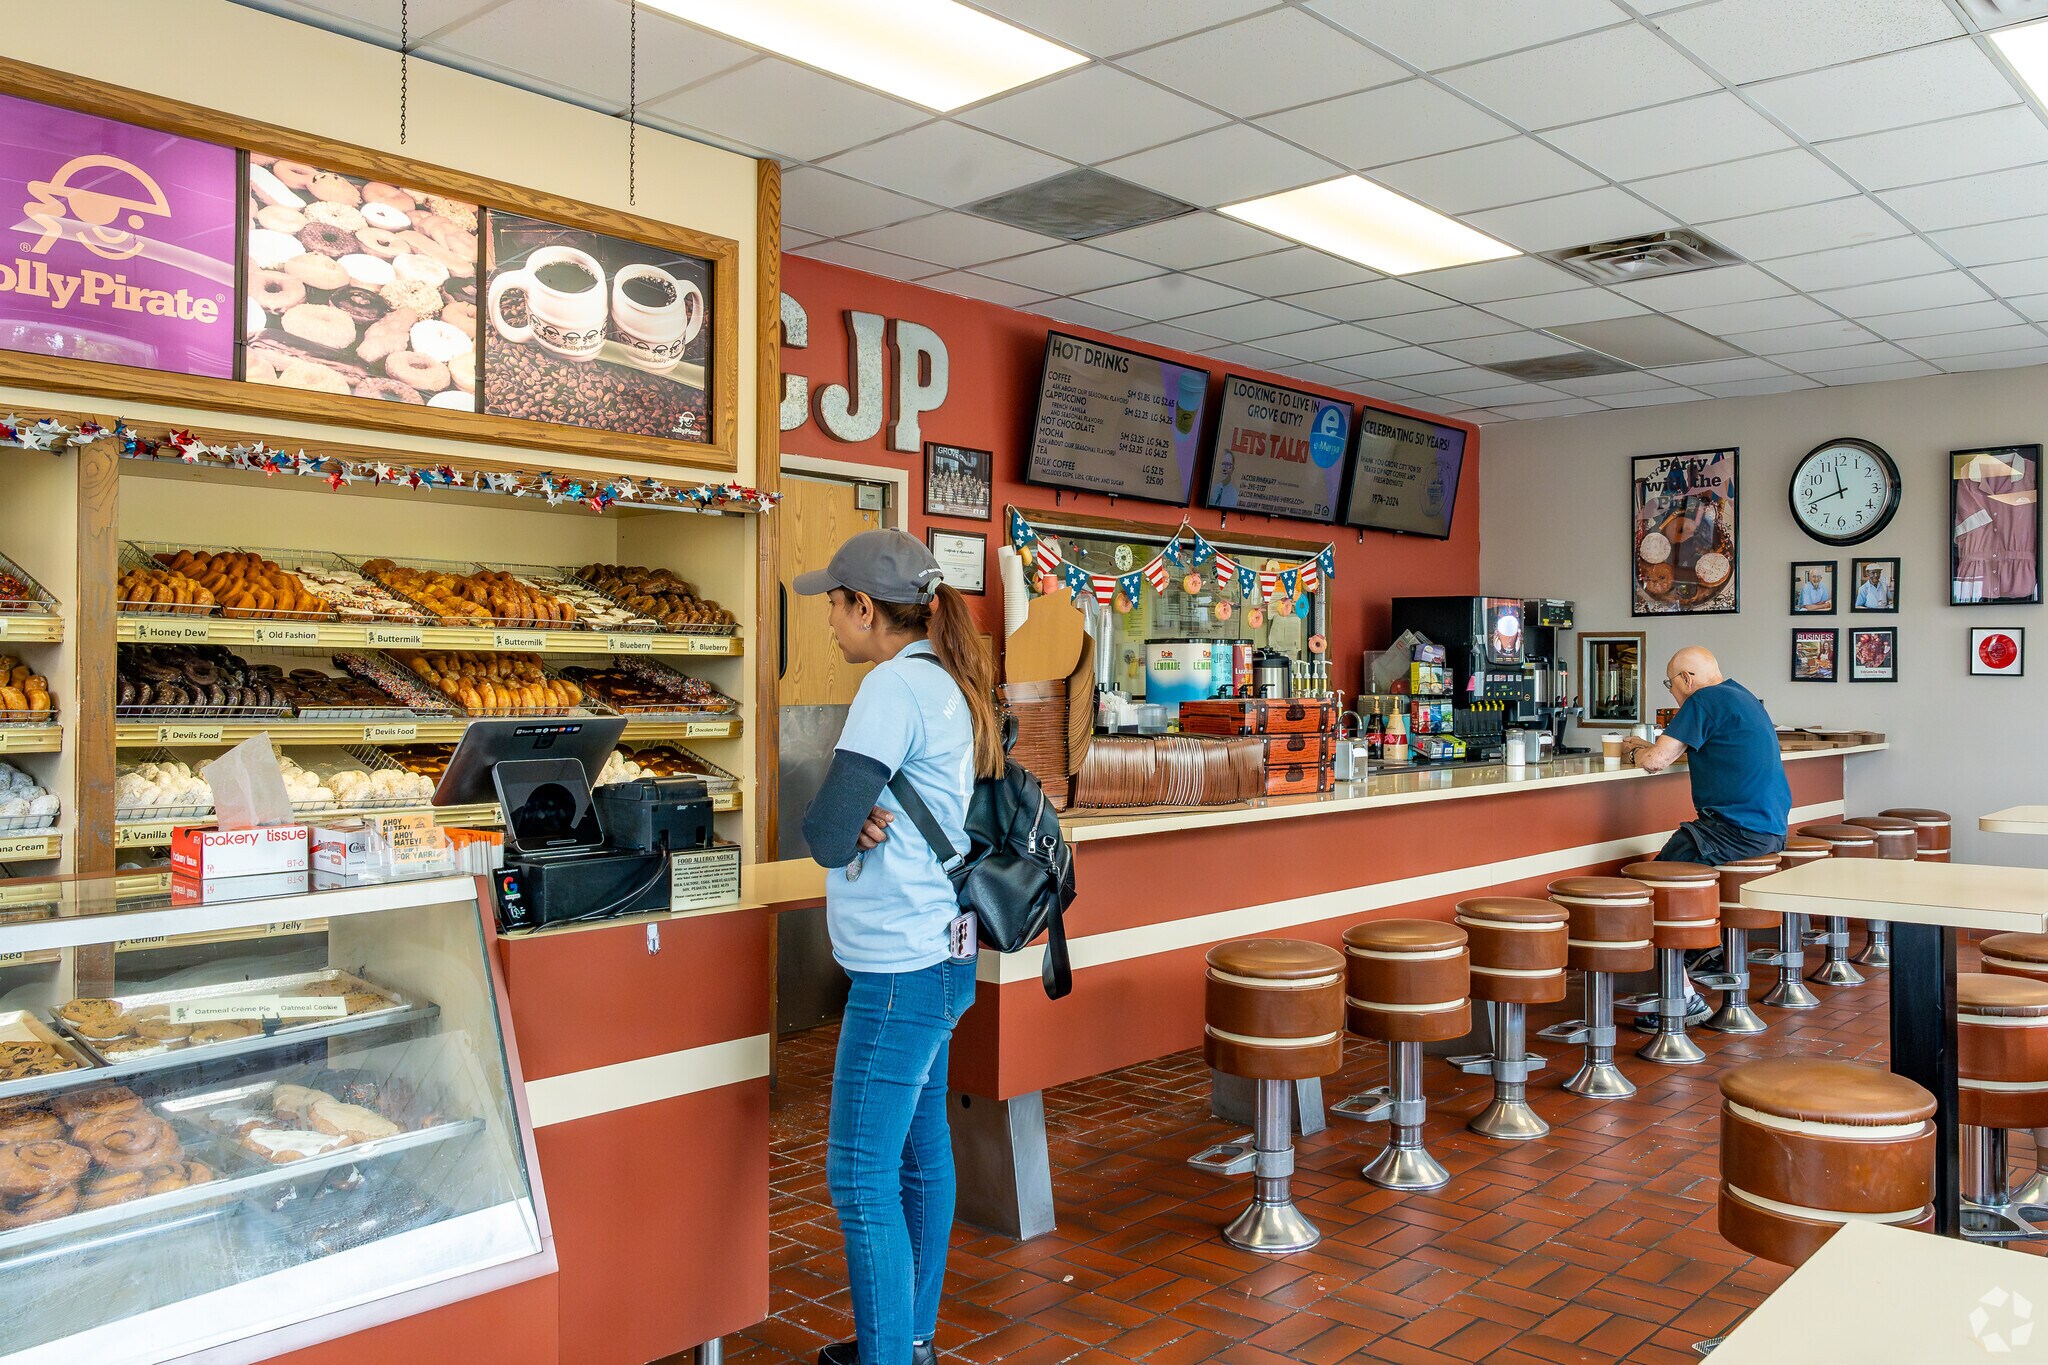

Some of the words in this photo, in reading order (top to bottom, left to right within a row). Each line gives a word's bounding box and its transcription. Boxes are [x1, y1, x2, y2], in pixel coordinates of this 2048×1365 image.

[1052, 340, 1082, 362] HOT
[1084, 347, 1129, 373] DRINKS
[1048, 371, 1071, 383] COFFEE
[1127, 390, 1136, 399] SM
[1152, 396, 1160, 404] LG
[1234, 382, 1276, 403] LOOKING
[1278, 392, 1290, 406] TO
[1292, 395, 1309, 412] LIVE
[1310, 400, 1320, 412] IN
[1045, 390, 1086, 406] CAPPUCCINO
[1124, 407, 1134, 417] SM
[1134, 409, 1149, 420] $3.25
[1151, 413, 1158, 422] LG
[1248, 404, 1278, 422] GROVE
[1280, 411, 1303, 427] CITY?
[1041, 415, 1056, 425] HOT
[1057, 419, 1095, 433] CHOCOLATE
[1120, 432, 1130, 441] SM
[1130, 433, 1145, 444] $3.25
[1147, 437, 1154, 446] LG
[1364, 420, 1414, 443] CELEBRATING
[1415, 432, 1424, 446] 50
[1426, 434, 1450, 451] YEARS!
[1039, 427, 1064, 438] MOCHA
[1119, 443, 1128, 452] SM
[1128, 445, 1143, 455] $3.25
[1145, 447, 1152, 456] LG
[1035, 456, 1051, 467] BULK
[1053, 459, 1076, 471] COFFEE
[1036, 445, 1047, 455] TEA
[1142, 465, 1150, 474] LG
[1659, 457, 1708, 472] Party
[1834, 456, 1847, 467] 12
[1854, 459, 1859, 469] 1
[1821, 462, 1831, 473] 11
[1864, 467, 1872, 478] 2
[1693, 474, 1721, 488] the
[1810, 474, 1823, 485] 10
[1804, 488, 1813, 499] 9
[1871, 483, 1879, 493] 3
[1809, 503, 1818, 514] 8
[1865, 498, 1873, 509] 4
[1823, 513, 1830, 524] 7
[1837, 515, 1846, 527] 6
[1855, 511, 1863, 522] 5
[150, 628, 182, 638] Honey
[184, 628, 207, 637] Dew
[268, 631, 283, 639] Old
[285, 631, 316, 639] Fashion
[377, 635, 421, 643] Buttermilk
[504, 638, 543, 647] Buttermilk
[619, 642, 651, 651] Blueberry
[699, 644, 728, 652] Blueberry
[1154, 662, 1180, 670] LEMONADE
[172, 731, 197, 739] Devils
[199, 731, 219, 739] Food
[383, 818, 402, 826] AHOY
[133, 830, 167, 840] Vanilla
[203, 832, 259, 846] bakery
[266, 828, 307, 842] tissue
[394, 831, 414, 840] AHOY
[15, 843, 44, 852] Cream
[394, 838, 422, 847] MATEY!
[173, 851, 186, 866] bakery
[186, 854, 198, 867] tissue
[287, 859, 305, 868] BT-6
[281, 921, 302, 930] Jelly
[194, 1007, 229, 1015] Oatmeal
[231, 1004, 257, 1012] Crème
